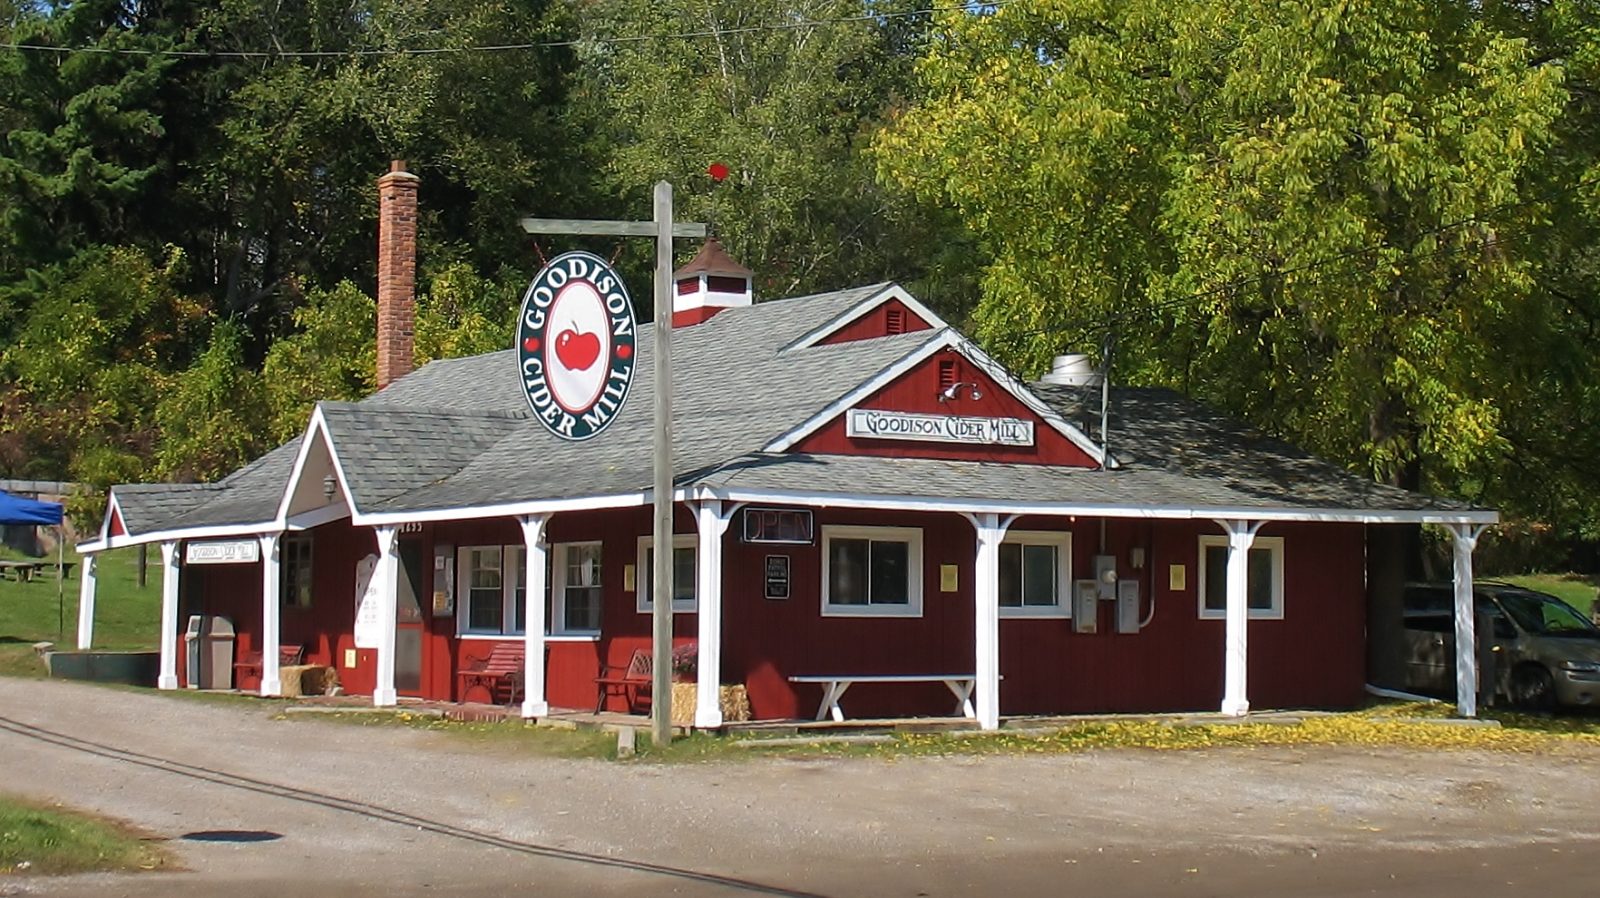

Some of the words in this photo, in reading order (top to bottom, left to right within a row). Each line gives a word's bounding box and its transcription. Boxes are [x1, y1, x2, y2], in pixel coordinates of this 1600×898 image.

[525, 258, 632, 336] GOODISON
[523, 357, 577, 437] CIDER
[581, 365, 631, 432] MILL
[866, 412, 942, 435] GOODISON
[945, 416, 985, 439] CIDER
[987, 419, 1020, 441] MILL
[746, 510, 810, 540] OPEN
